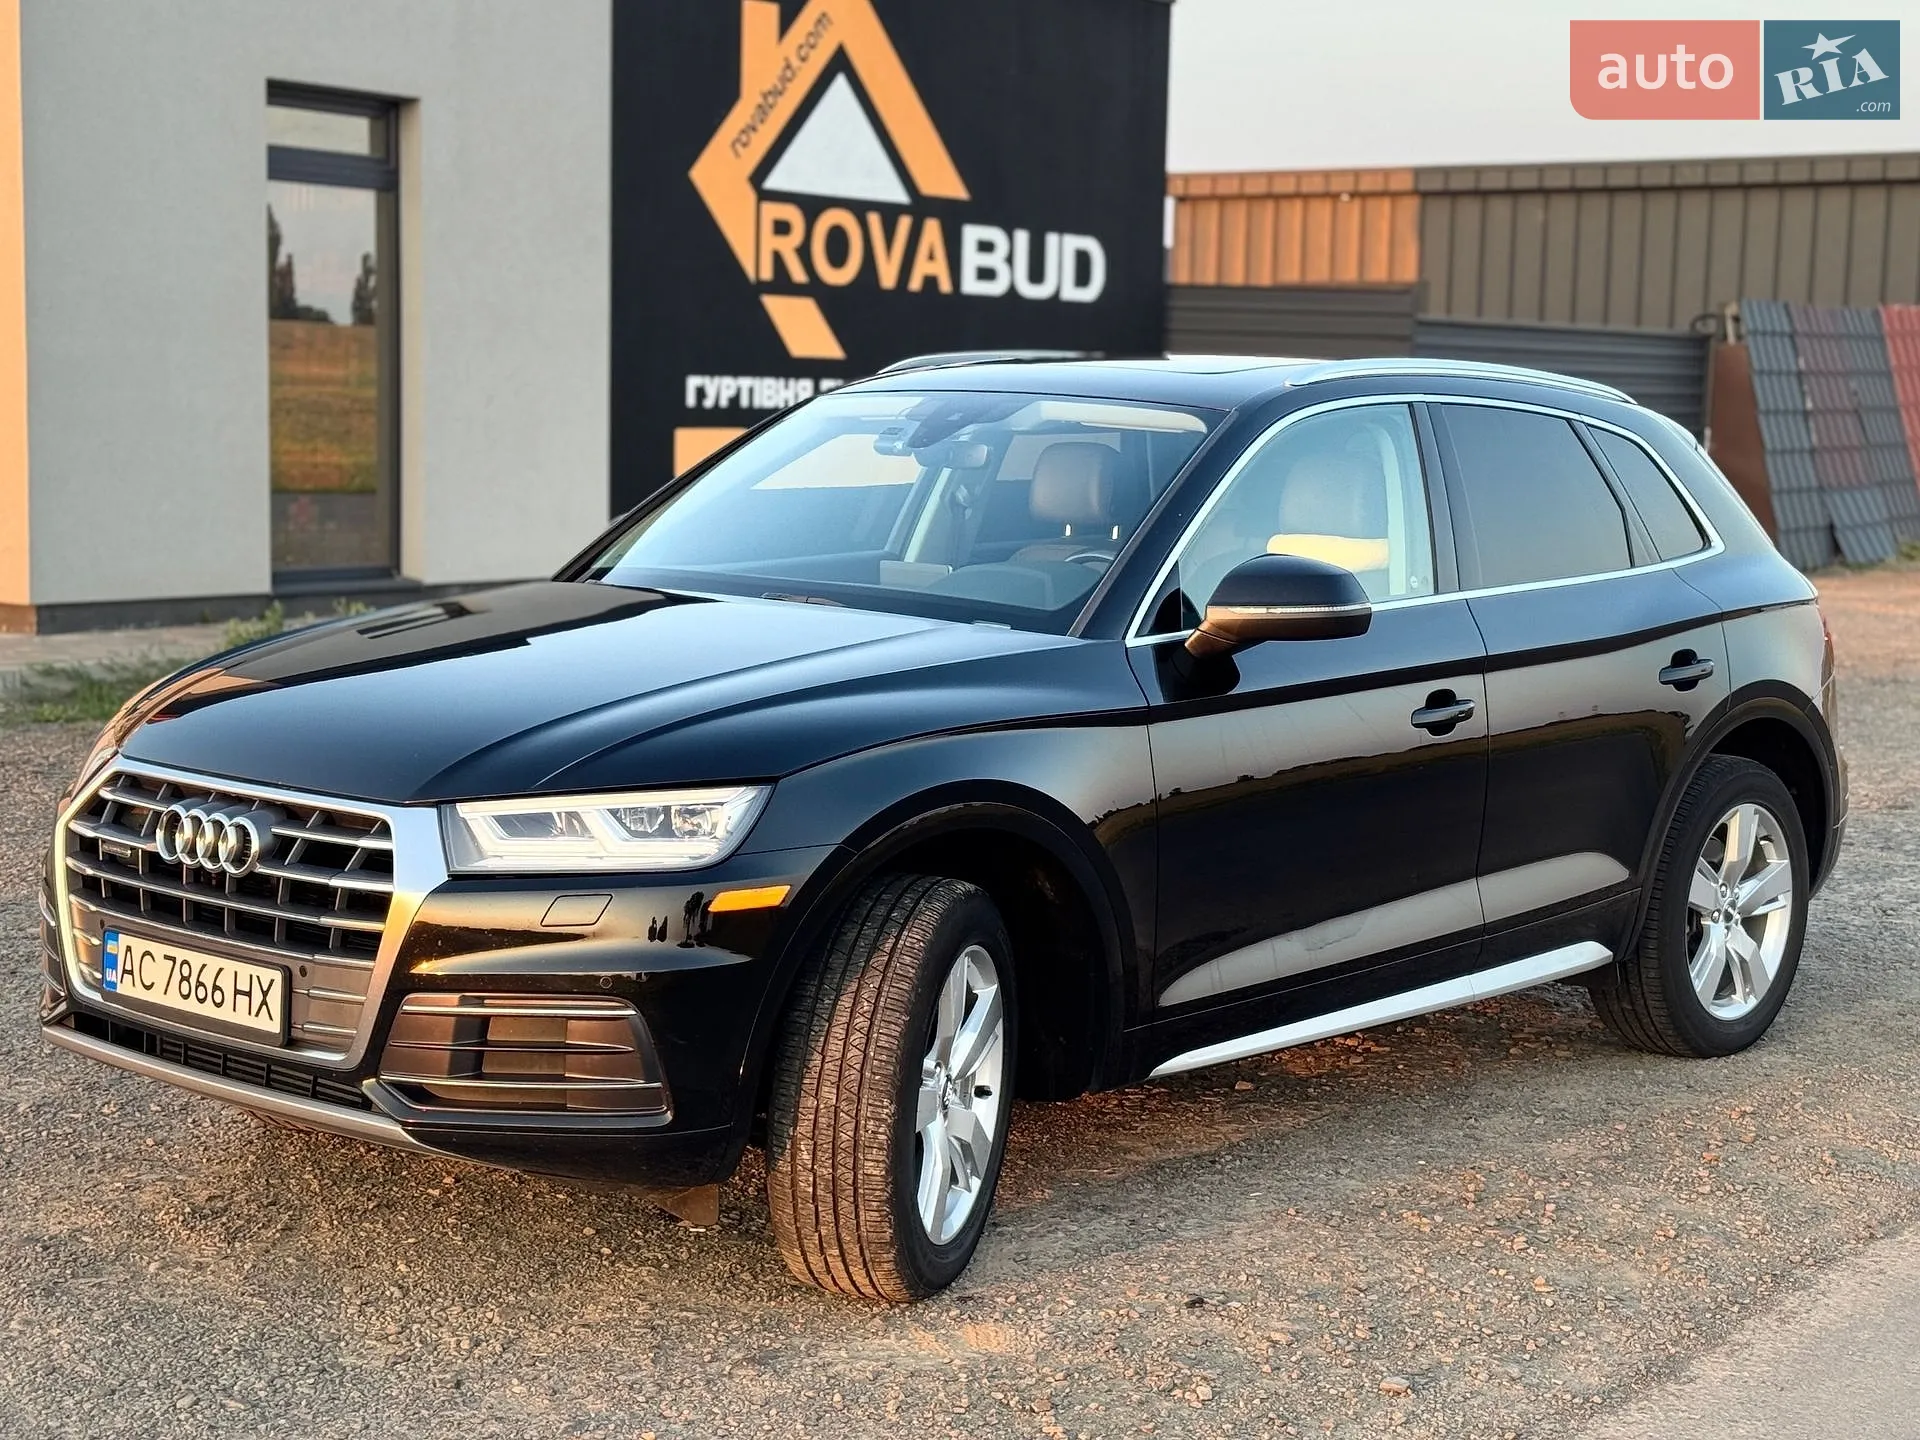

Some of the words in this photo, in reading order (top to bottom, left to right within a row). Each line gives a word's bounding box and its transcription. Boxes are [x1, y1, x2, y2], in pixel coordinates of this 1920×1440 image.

[730, 11, 834, 159] rovabud.com
[163, 954, 225, 1009] 7866
[232, 970, 275, 1022] HX
